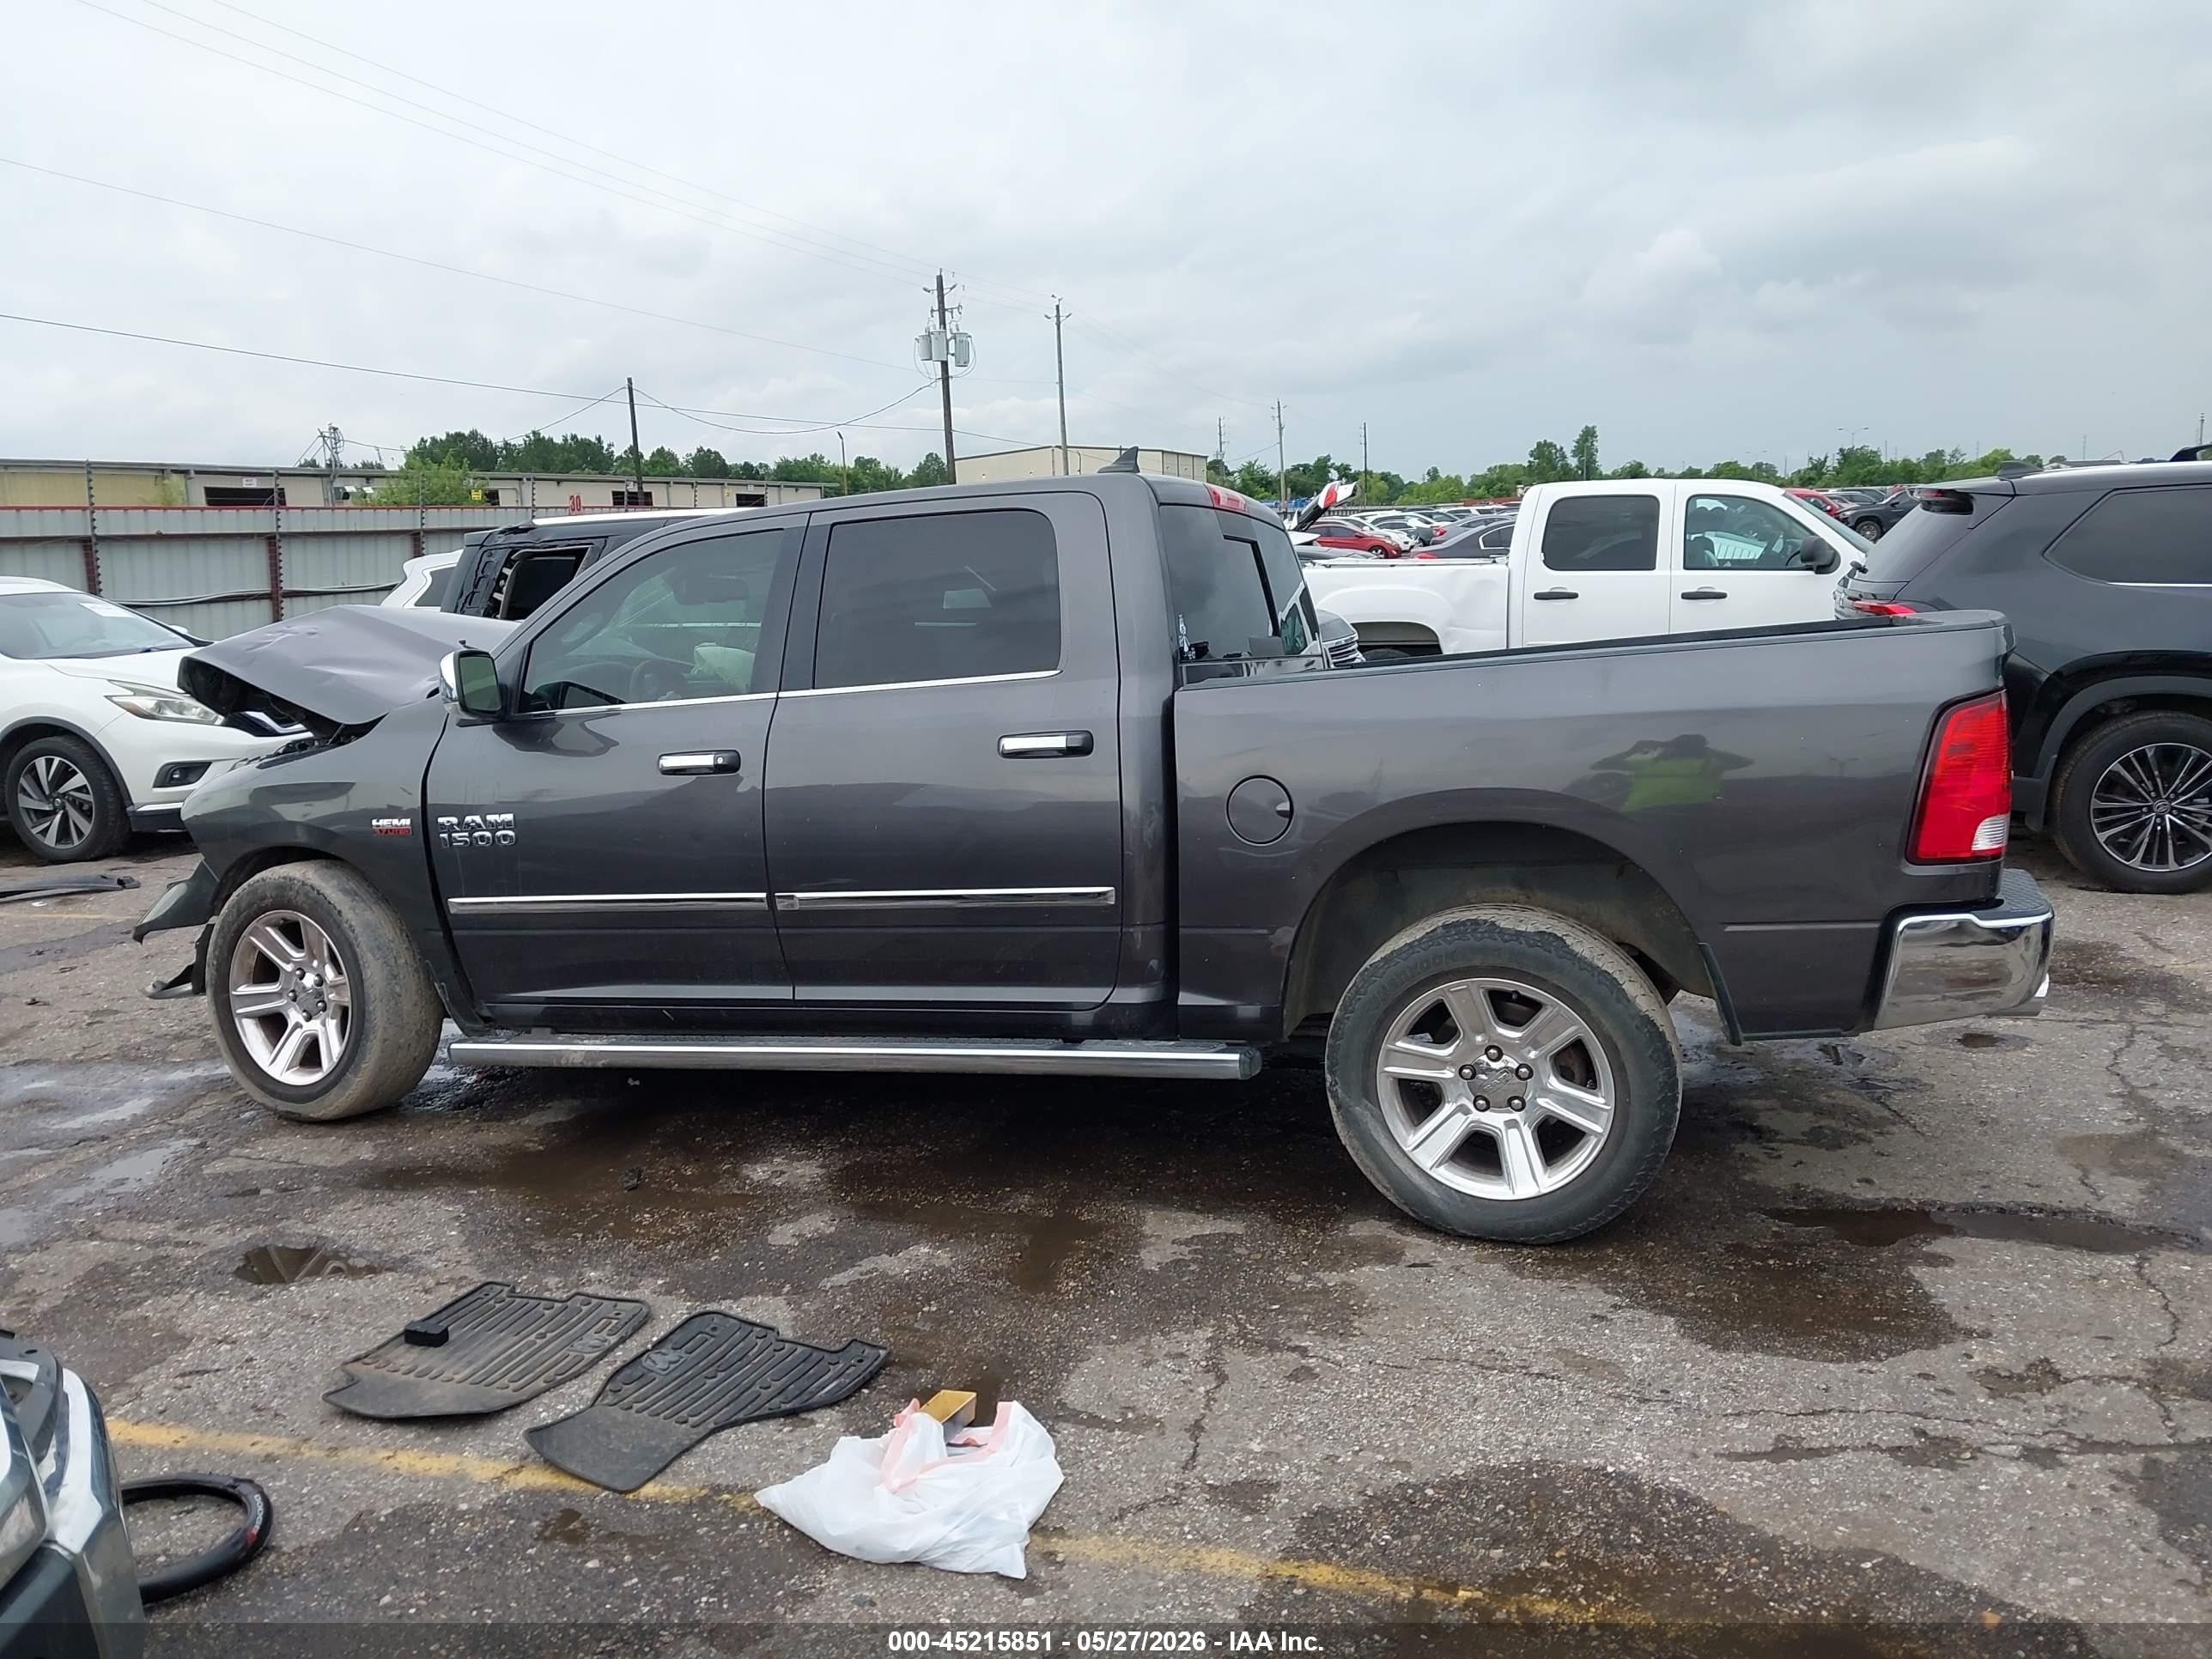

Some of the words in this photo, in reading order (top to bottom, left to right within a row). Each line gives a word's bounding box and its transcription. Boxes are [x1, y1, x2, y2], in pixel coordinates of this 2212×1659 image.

[569, 495, 581, 511] 30
[371, 818, 411, 827] HEMI
[438, 813, 515, 831] RAM
[440, 830, 515, 848] 1500
